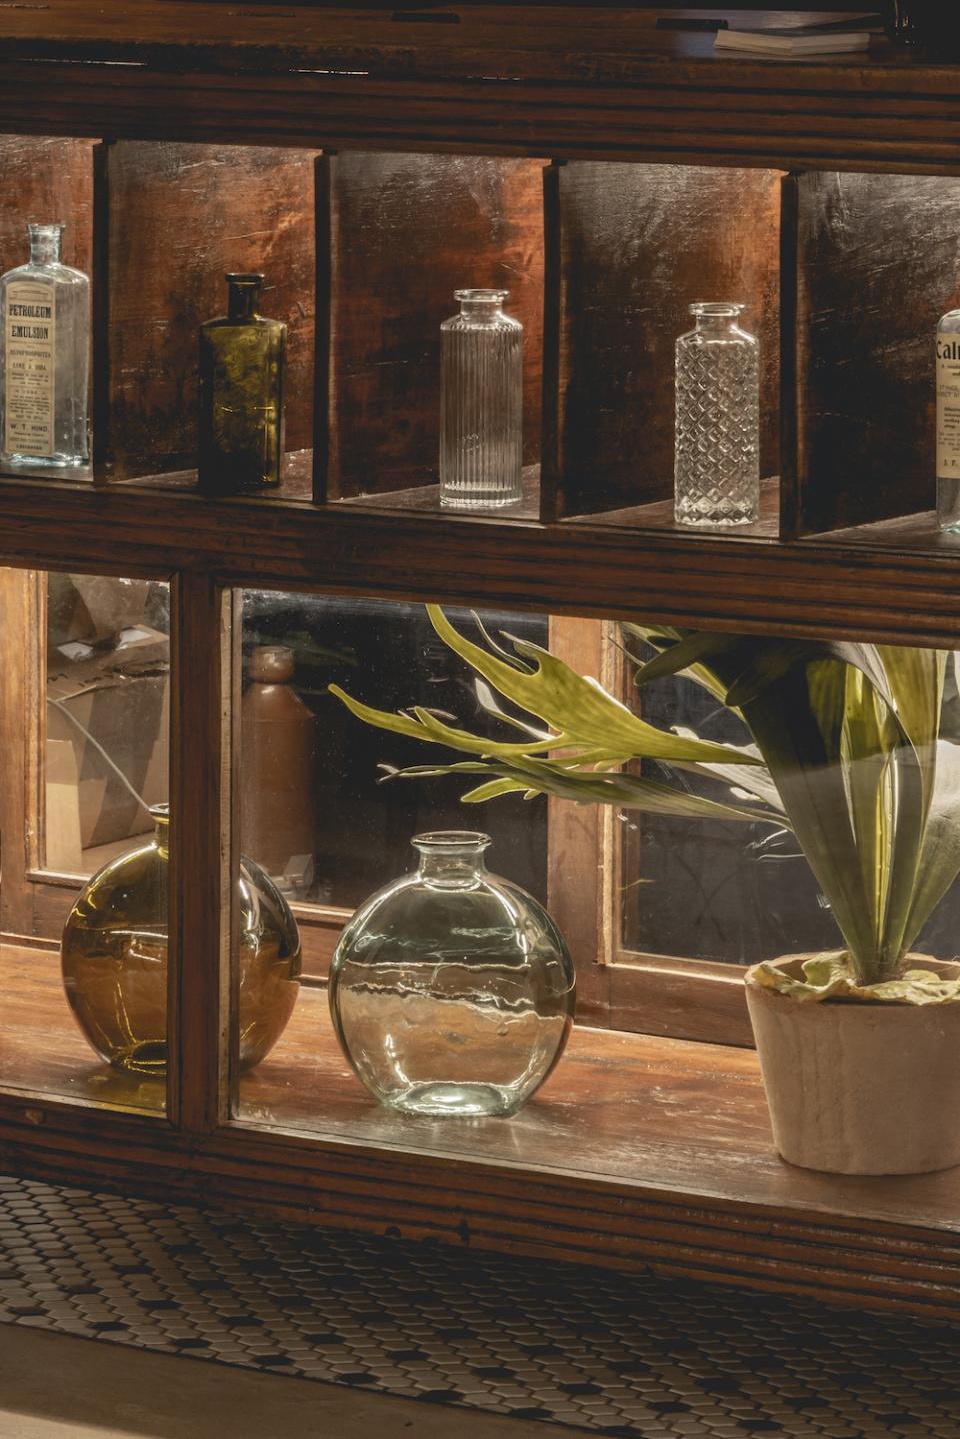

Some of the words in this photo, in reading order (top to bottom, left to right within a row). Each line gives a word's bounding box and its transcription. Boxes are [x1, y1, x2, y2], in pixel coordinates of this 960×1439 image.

[9, 304, 52, 319] PETROLEUM
[11, 325, 49, 340] EMULSION
[936, 340, 960, 360] Cal
